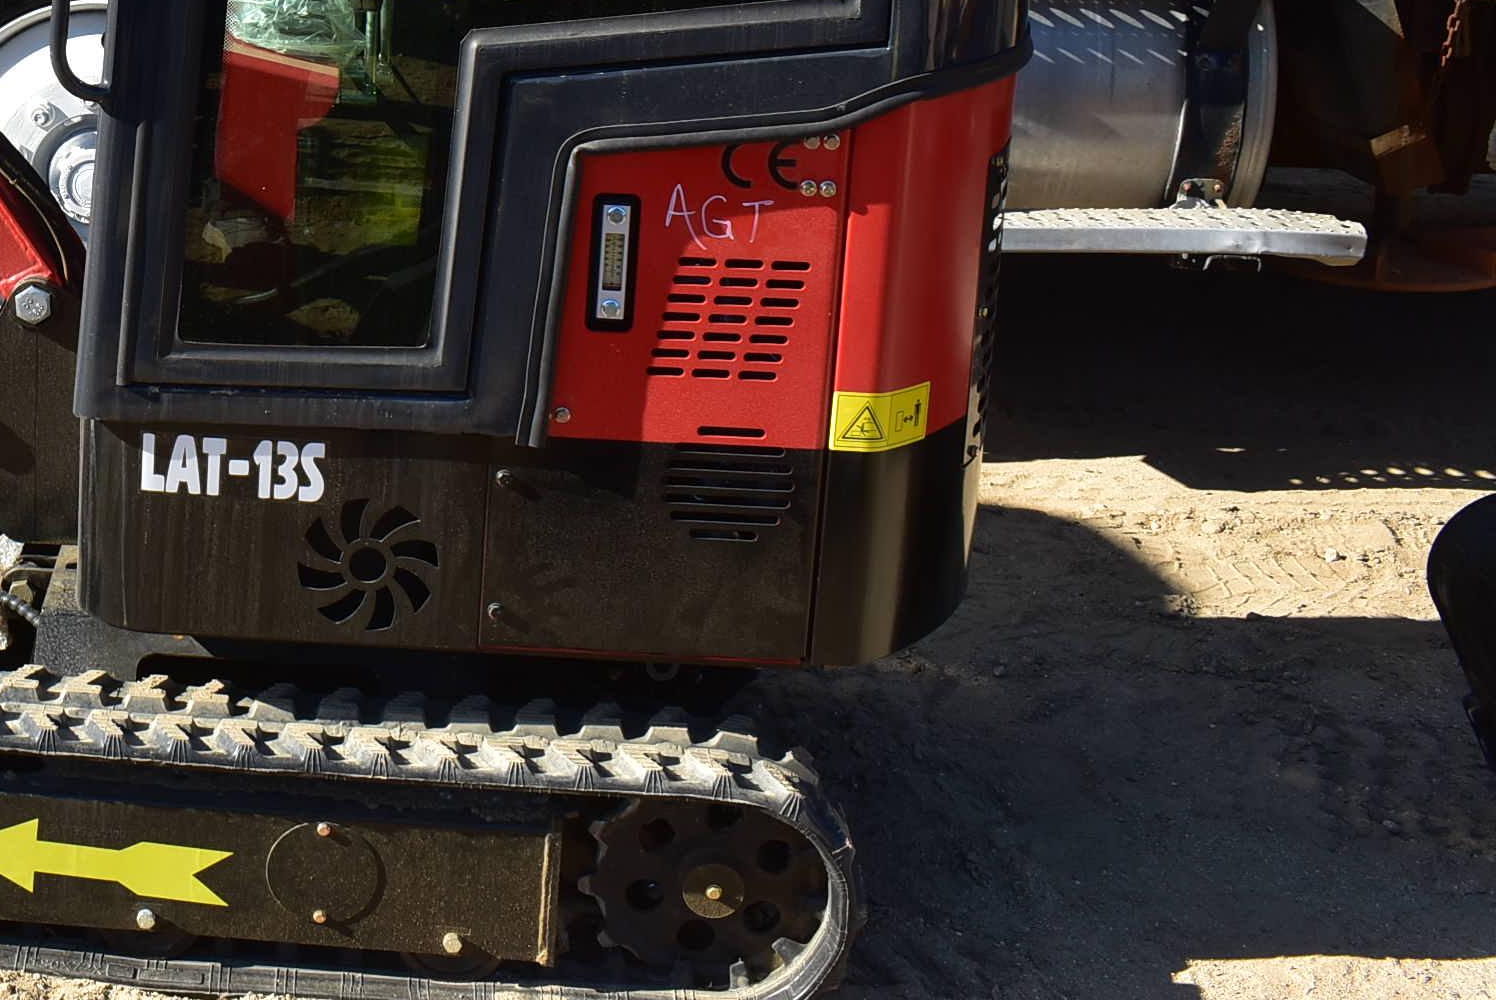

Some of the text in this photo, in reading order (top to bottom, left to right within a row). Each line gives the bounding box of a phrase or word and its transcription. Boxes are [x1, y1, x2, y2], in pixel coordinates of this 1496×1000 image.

[721, 141, 799, 190] CE
[665, 183, 775, 250] AGT
[140, 432, 326, 503] LAT-13S
